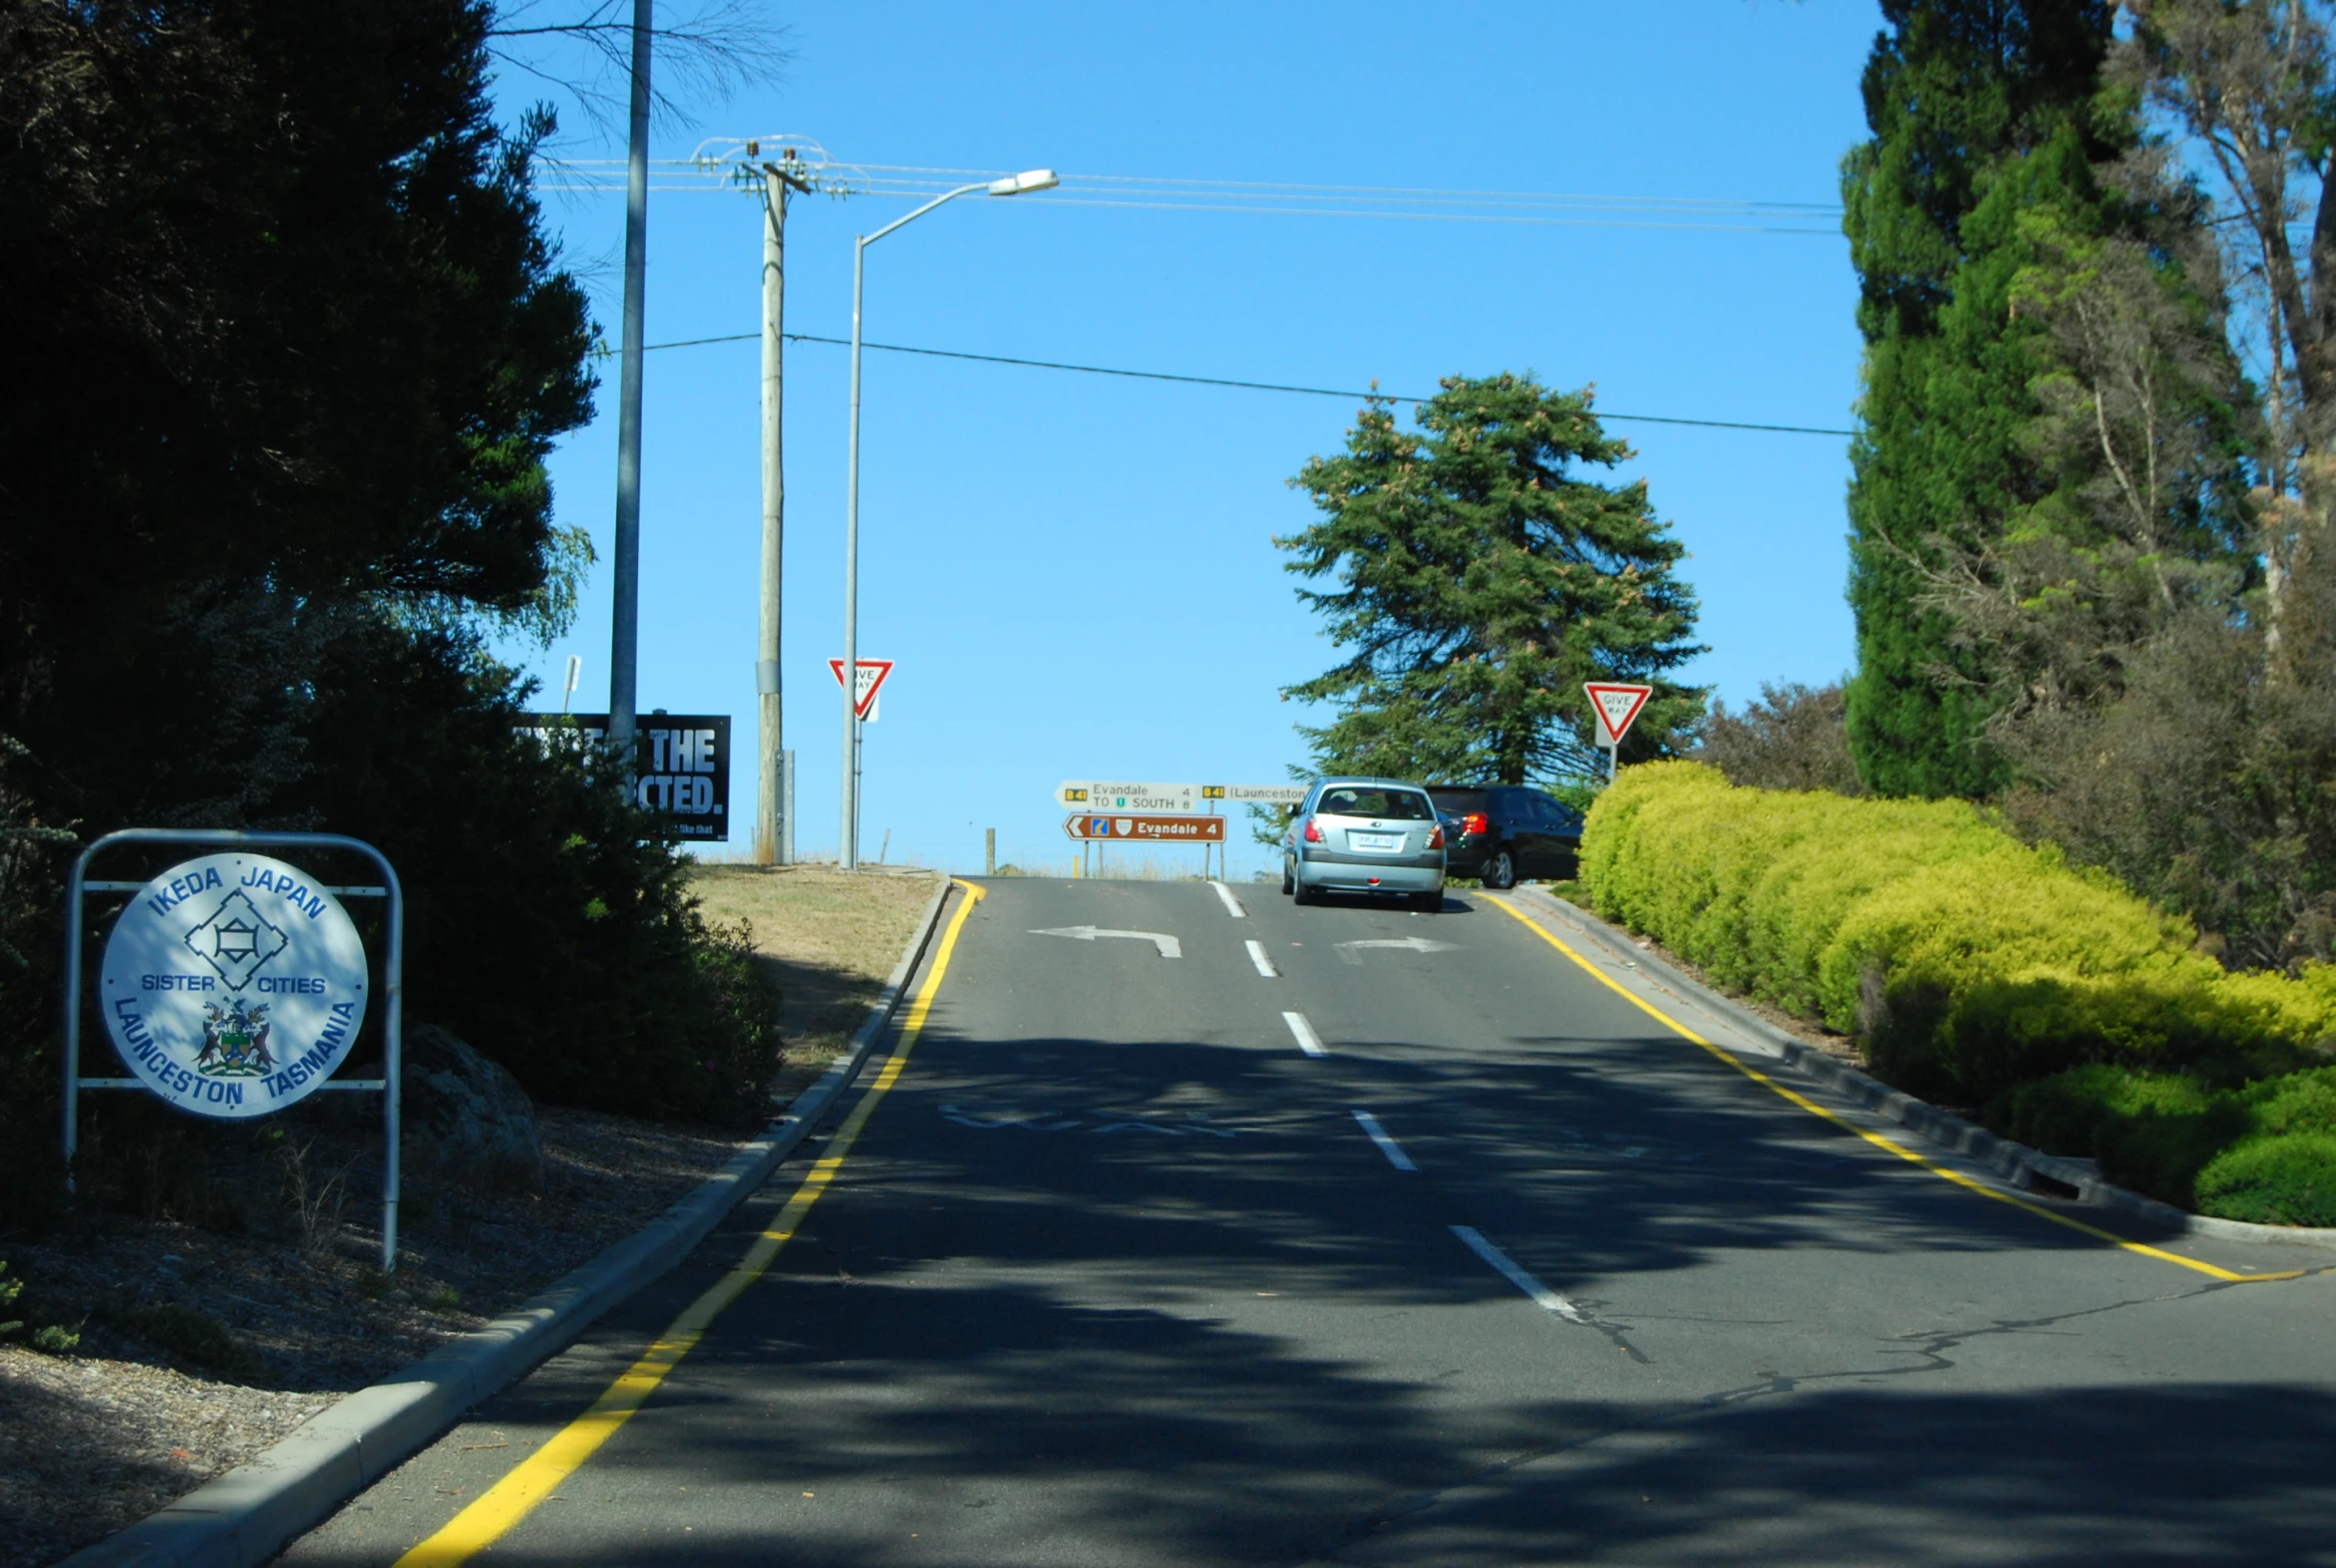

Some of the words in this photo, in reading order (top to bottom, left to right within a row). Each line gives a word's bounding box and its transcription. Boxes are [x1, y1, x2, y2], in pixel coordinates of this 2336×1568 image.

[1604, 694, 1631, 705] GIVE
[648, 730, 715, 773] THE
[1093, 784, 1149, 795] Evandale
[1094, 797, 1110, 806] TO
[1133, 798, 1174, 808] SOUTH
[696, 824, 713, 833] that
[1138, 822, 1197, 834] Evandale
[1206, 823, 1217, 834] 4
[148, 867, 223, 916] IKEDA
[241, 866, 327, 919] JAPAN
[142, 975, 215, 991] SISTER
[257, 977, 326, 994] CITIES
[115, 997, 243, 1104] LAUNCESTON
[260, 1001, 355, 1098] TASMANIA
